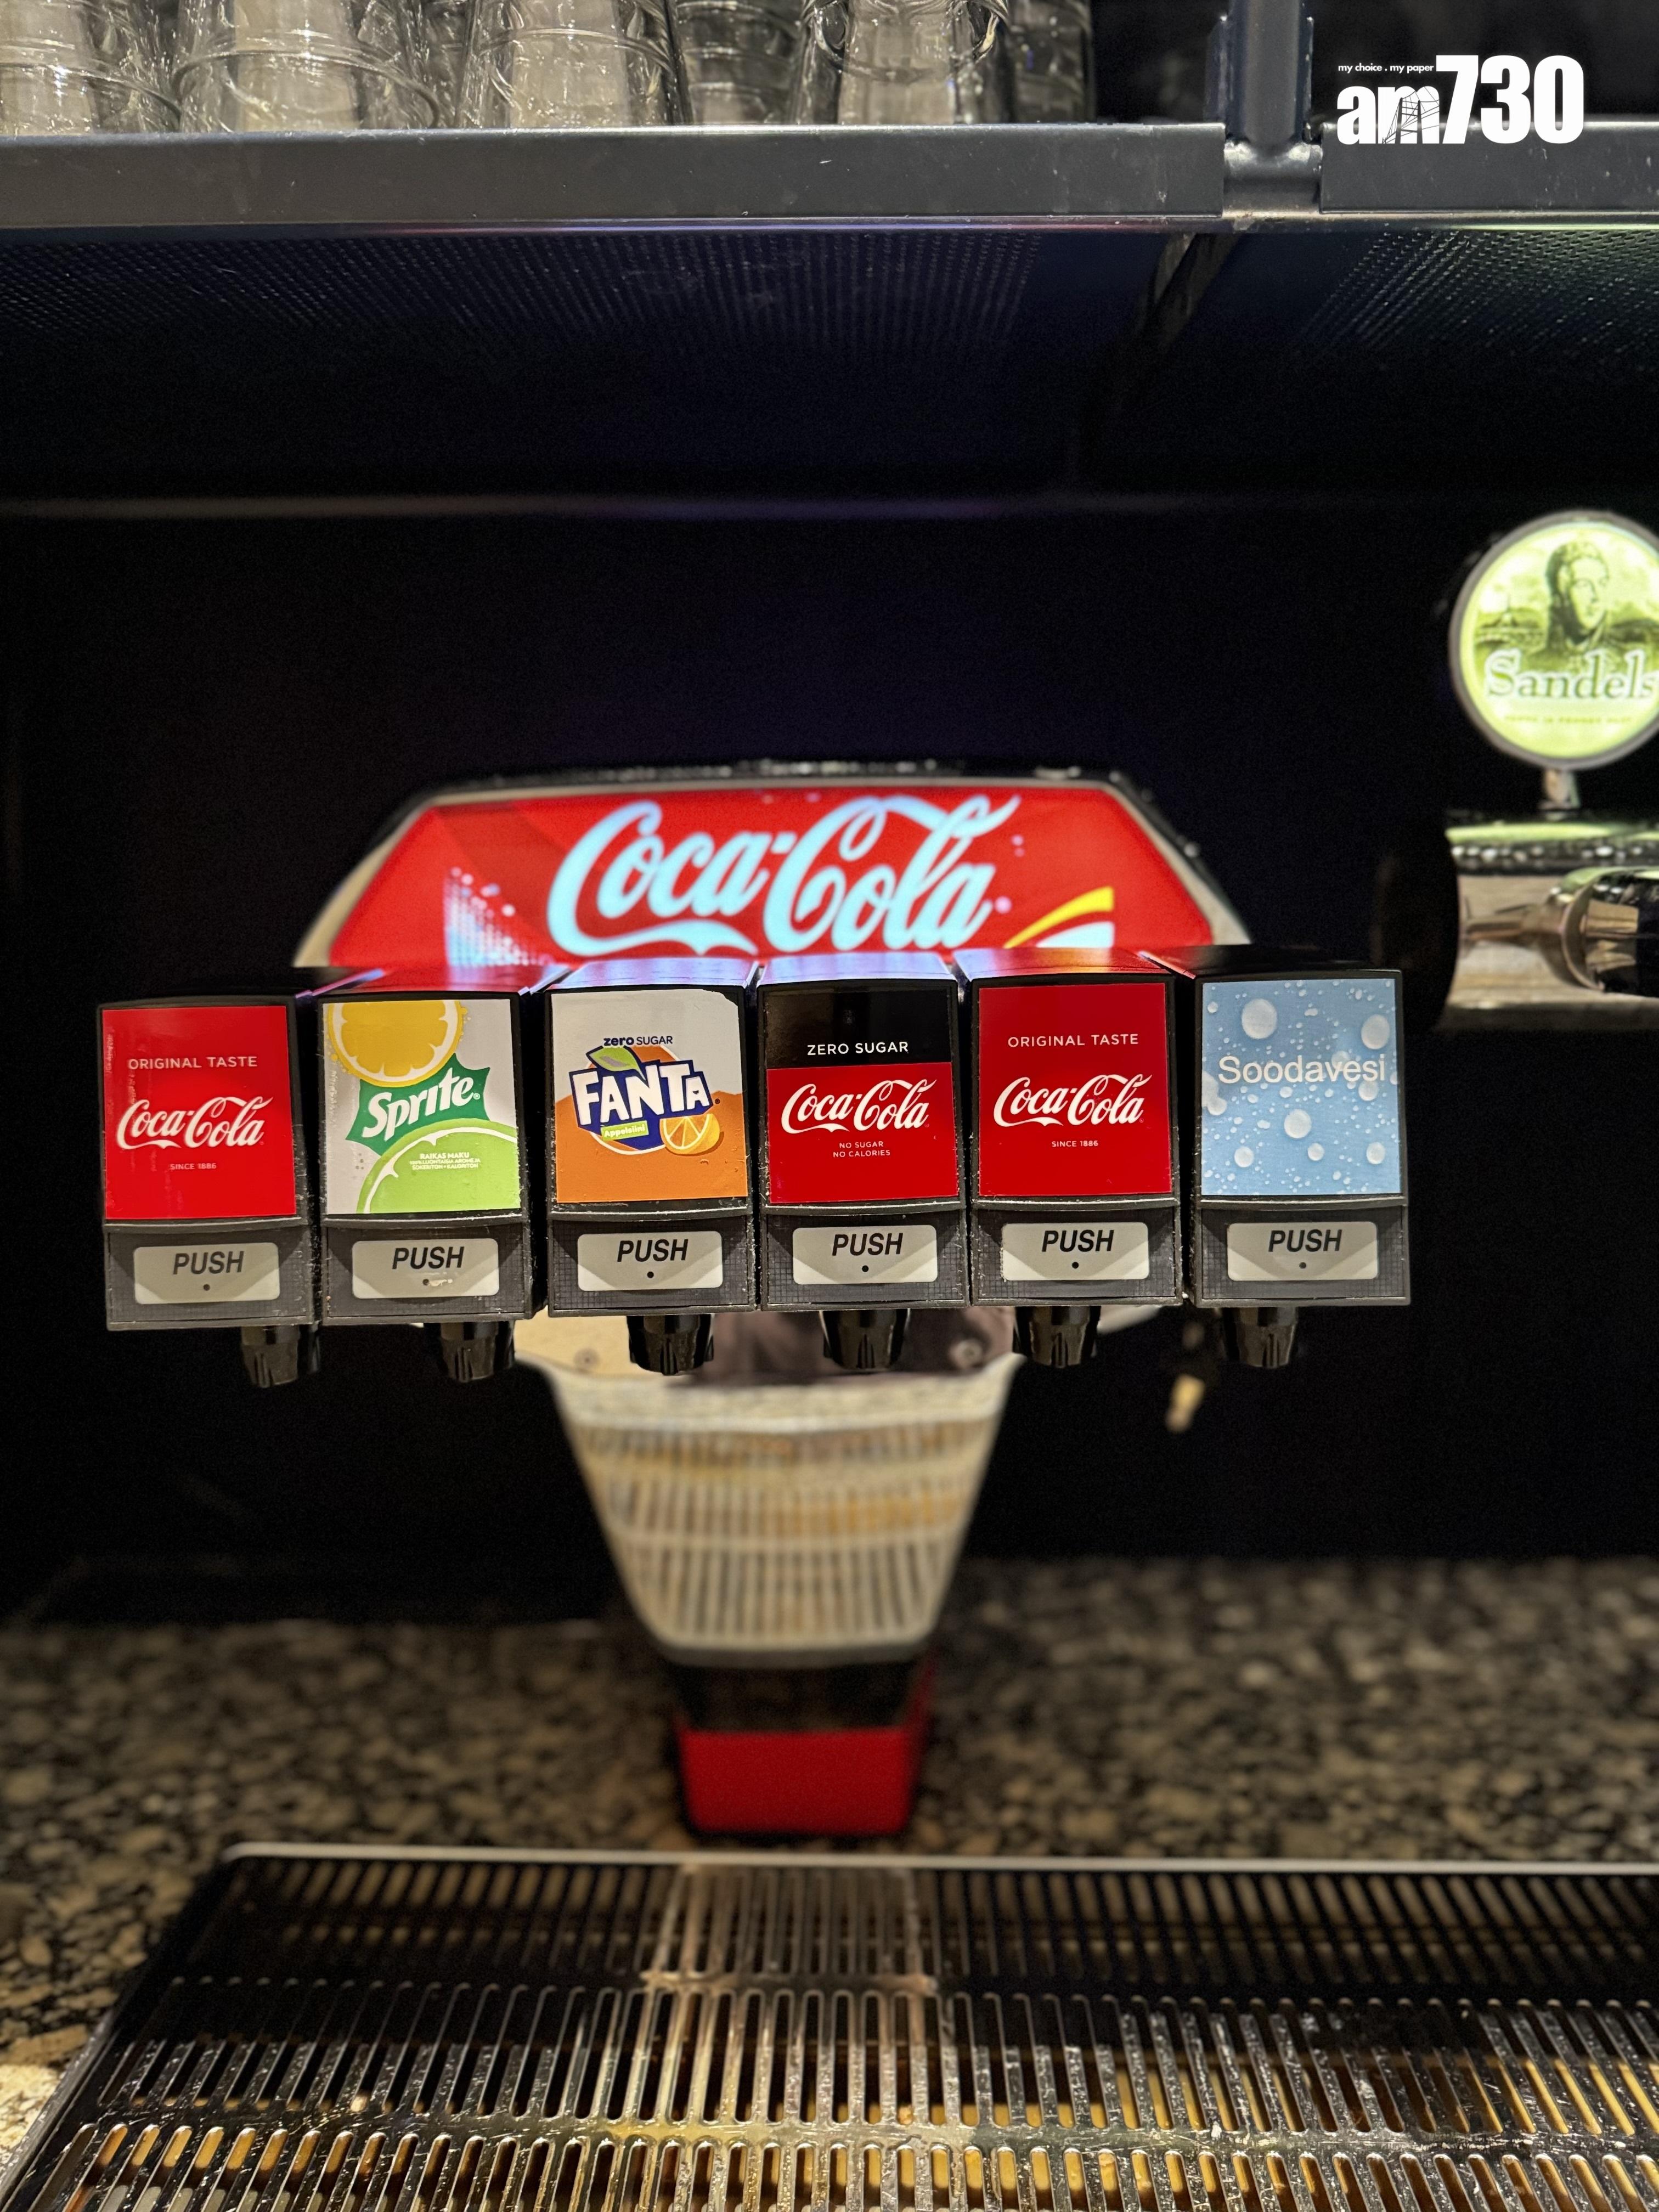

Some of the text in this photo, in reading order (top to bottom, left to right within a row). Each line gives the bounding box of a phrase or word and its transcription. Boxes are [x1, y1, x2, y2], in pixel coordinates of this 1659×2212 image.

[1485, 648, 1657, 700] Sandels
[548, 794, 1021, 956] Coca-Cola
[603, 1036, 673, 1046] zero SUGAR
[807, 1041, 909, 1056] ZERO SUGAR
[1008, 1034, 1138, 1047] ORIGINAL TASTE
[128, 1056, 257, 1070] ORIGINAL TASTE
[1218, 1054, 1386, 1084] Soodavesi
[362, 1068, 474, 1141] Sprite
[572, 1063, 710, 1126] FANTA
[993, 1074, 1152, 1127] Coca-Cola
[781, 1079, 937, 1134] Coca-Cola
[117, 1096, 273, 1149] Coca-Cola
[604, 1124, 645, 1137] Appelsiini
[617, 1239, 689, 1262] PUSH
[832, 1233, 904, 1256] PUSH
[1042, 1229, 1114, 1252] PUSH
[1268, 1229, 1342, 1252] PUSH
[173, 1251, 244, 1275] PUSH
[392, 1246, 464, 1269] PUSH
